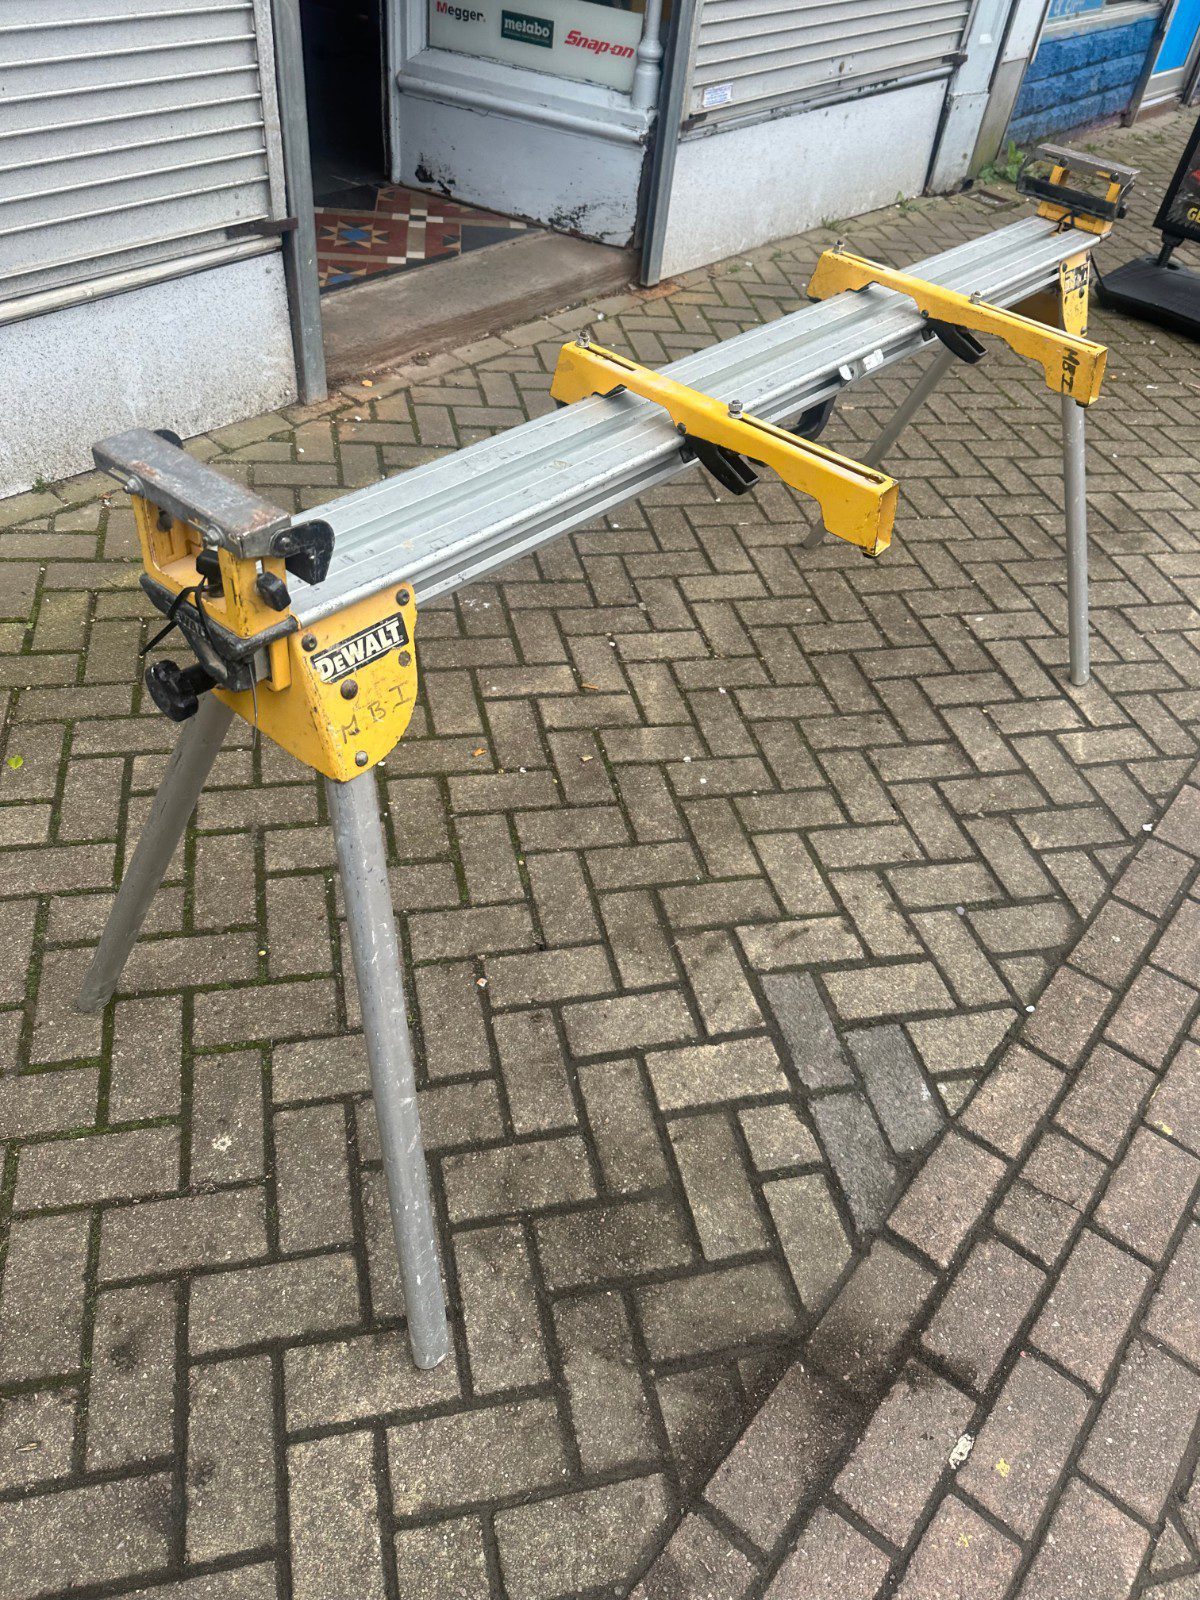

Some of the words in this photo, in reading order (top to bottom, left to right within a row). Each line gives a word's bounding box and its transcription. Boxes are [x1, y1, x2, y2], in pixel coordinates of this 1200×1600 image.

[437, 1, 484, 21] Megger
[504, 18, 550, 38] metabo
[564, 30, 635, 59] Snap-on
